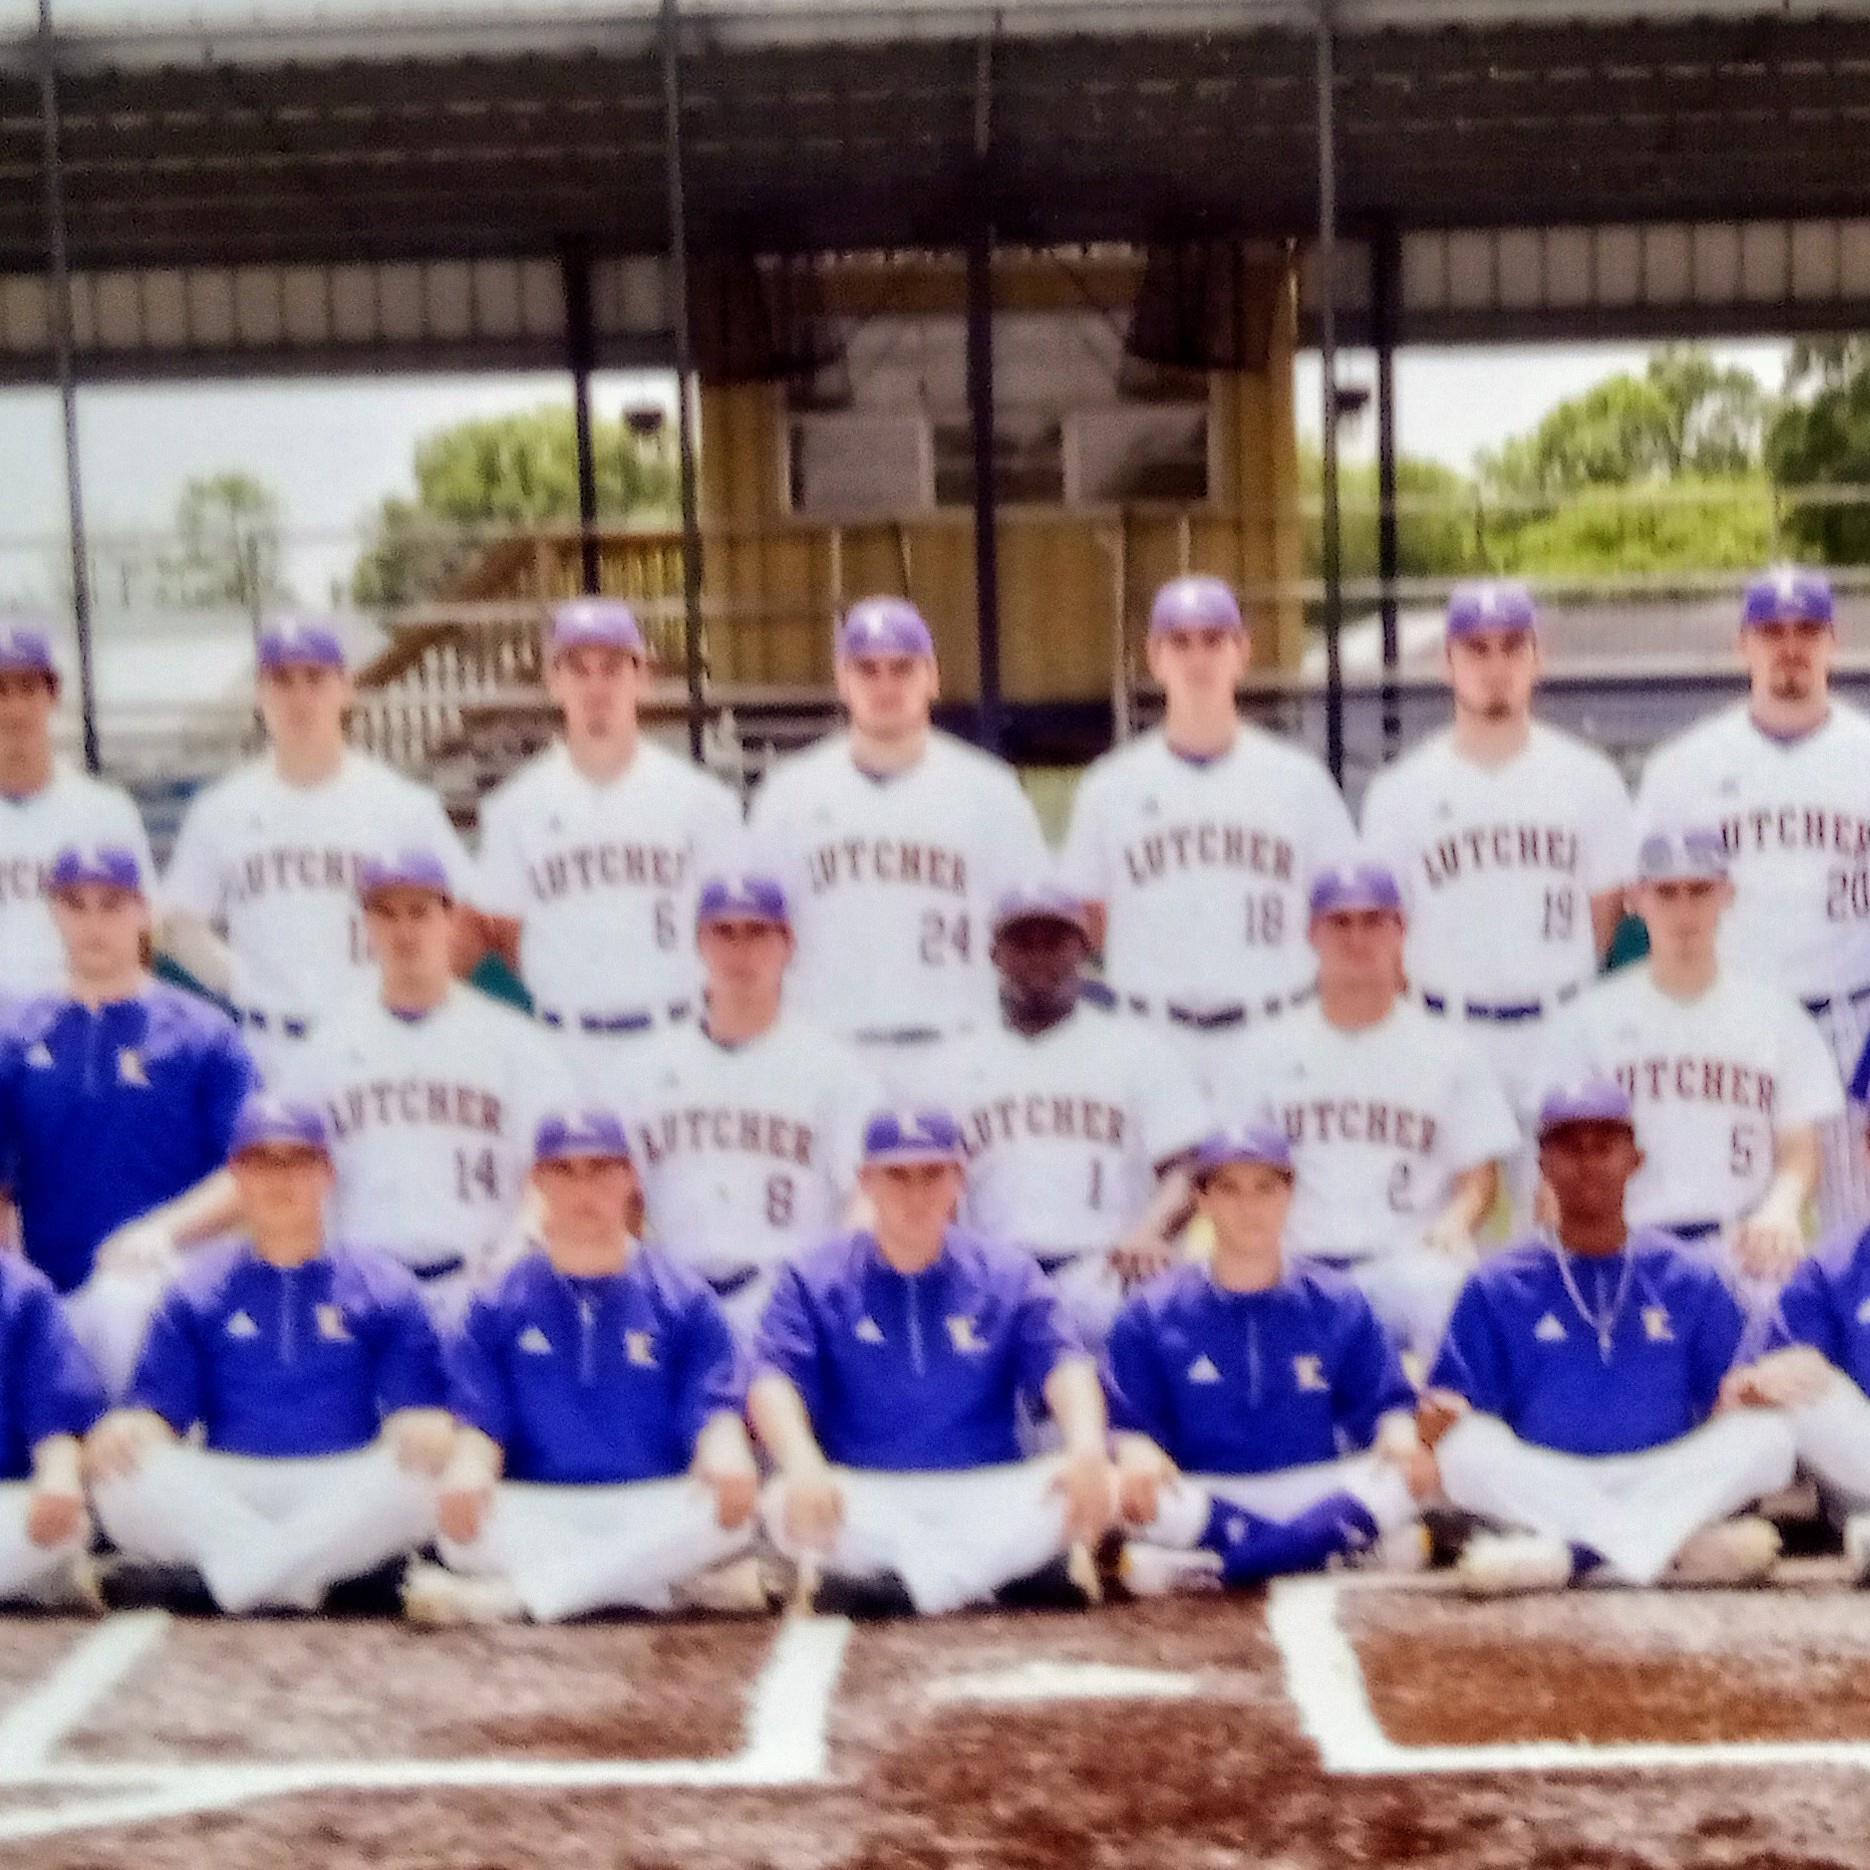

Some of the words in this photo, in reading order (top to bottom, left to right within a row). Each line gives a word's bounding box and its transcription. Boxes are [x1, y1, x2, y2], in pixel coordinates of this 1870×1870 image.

[1121, 821, 1294, 887] LUTCHER
[1718, 806, 1870, 858] UTCHER
[654, 893, 676, 951] 6
[1245, 889, 1284, 948] 18
[1827, 864, 1870, 923] 20
[918, 906, 970, 967] 24
[326, 1080, 502, 1139] LUTCHER
[1614, 1055, 1775, 1115] UTCHER
[637, 1106, 813, 1166] LUTCHER
[1730, 1121, 1755, 1178] 5
[456, 1148, 499, 1203] 14
[766, 1174, 794, 1229] 8
[1088, 1156, 1103, 1212] 1
[1388, 1159, 1414, 1214] 2
